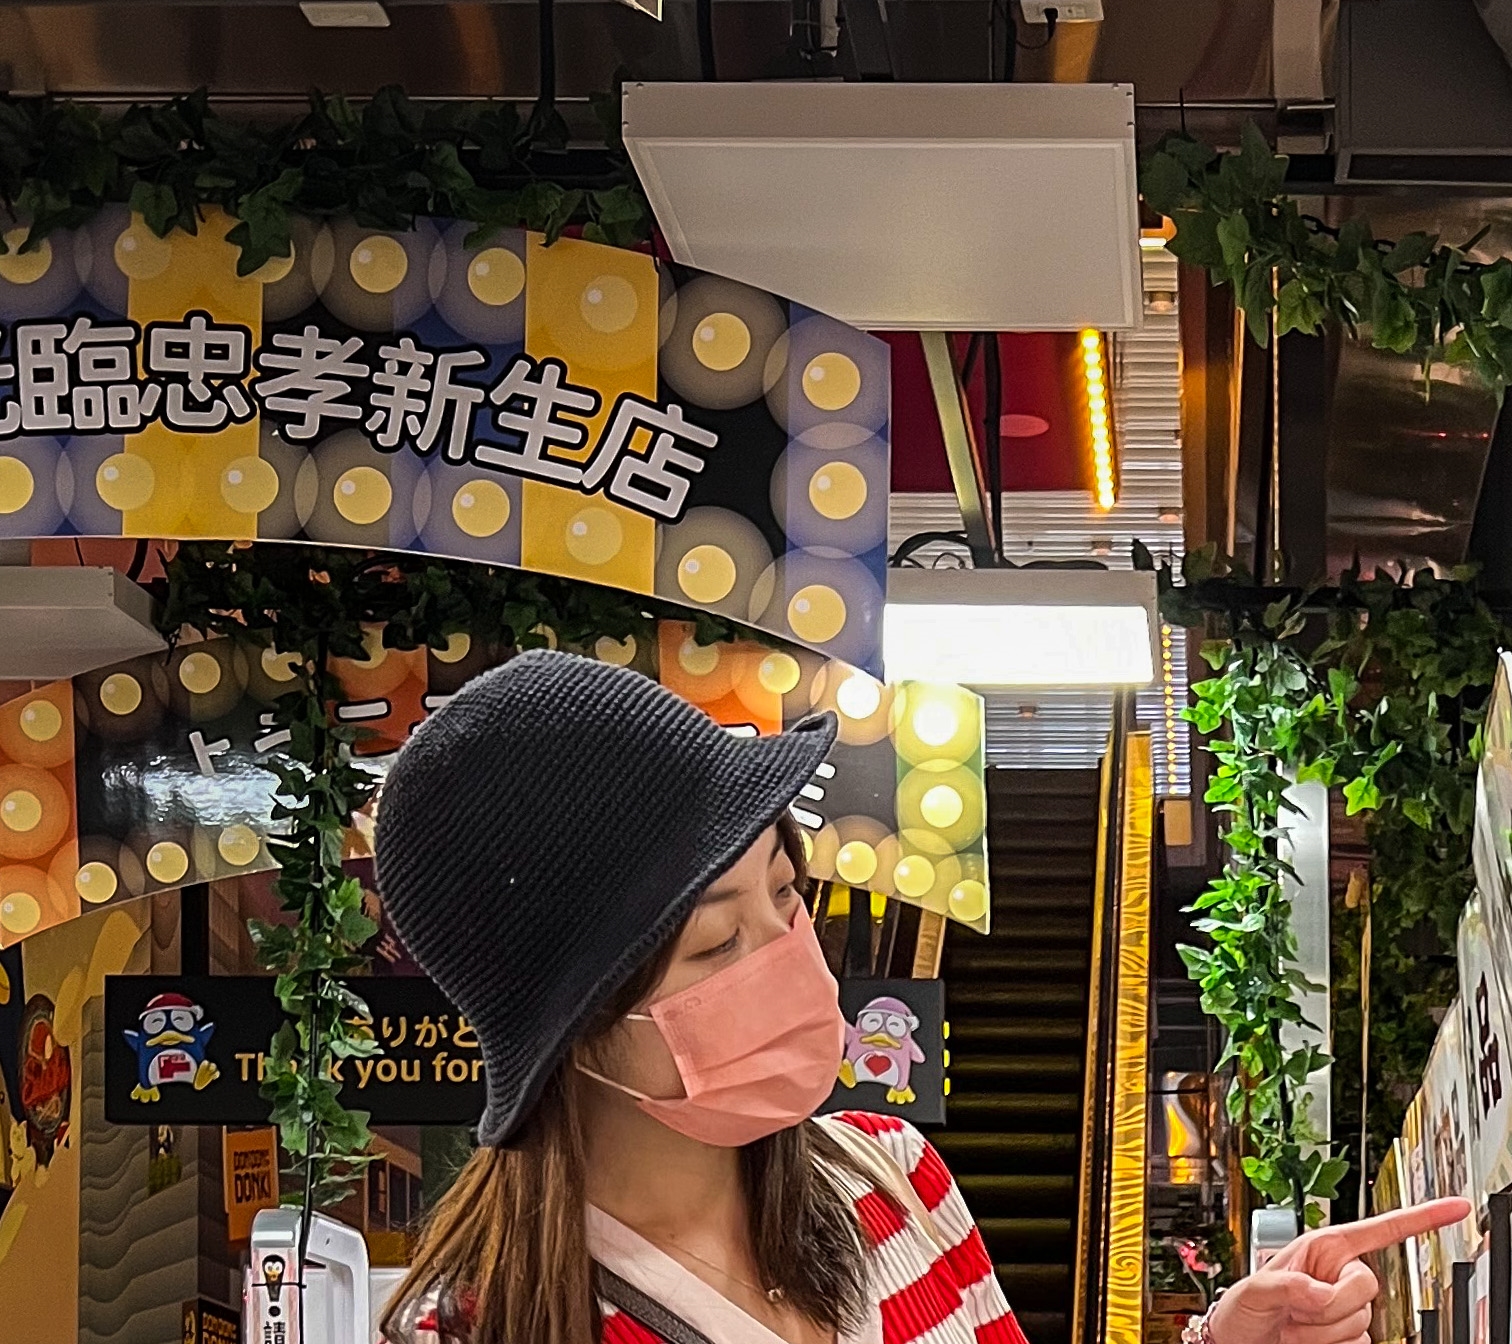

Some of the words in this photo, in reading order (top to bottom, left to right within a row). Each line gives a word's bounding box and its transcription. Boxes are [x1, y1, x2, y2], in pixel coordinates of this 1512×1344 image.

[355, 1058, 422, 1089] you
[431, 1051, 486, 1082] for
[234, 1171, 272, 1203] DONKI
